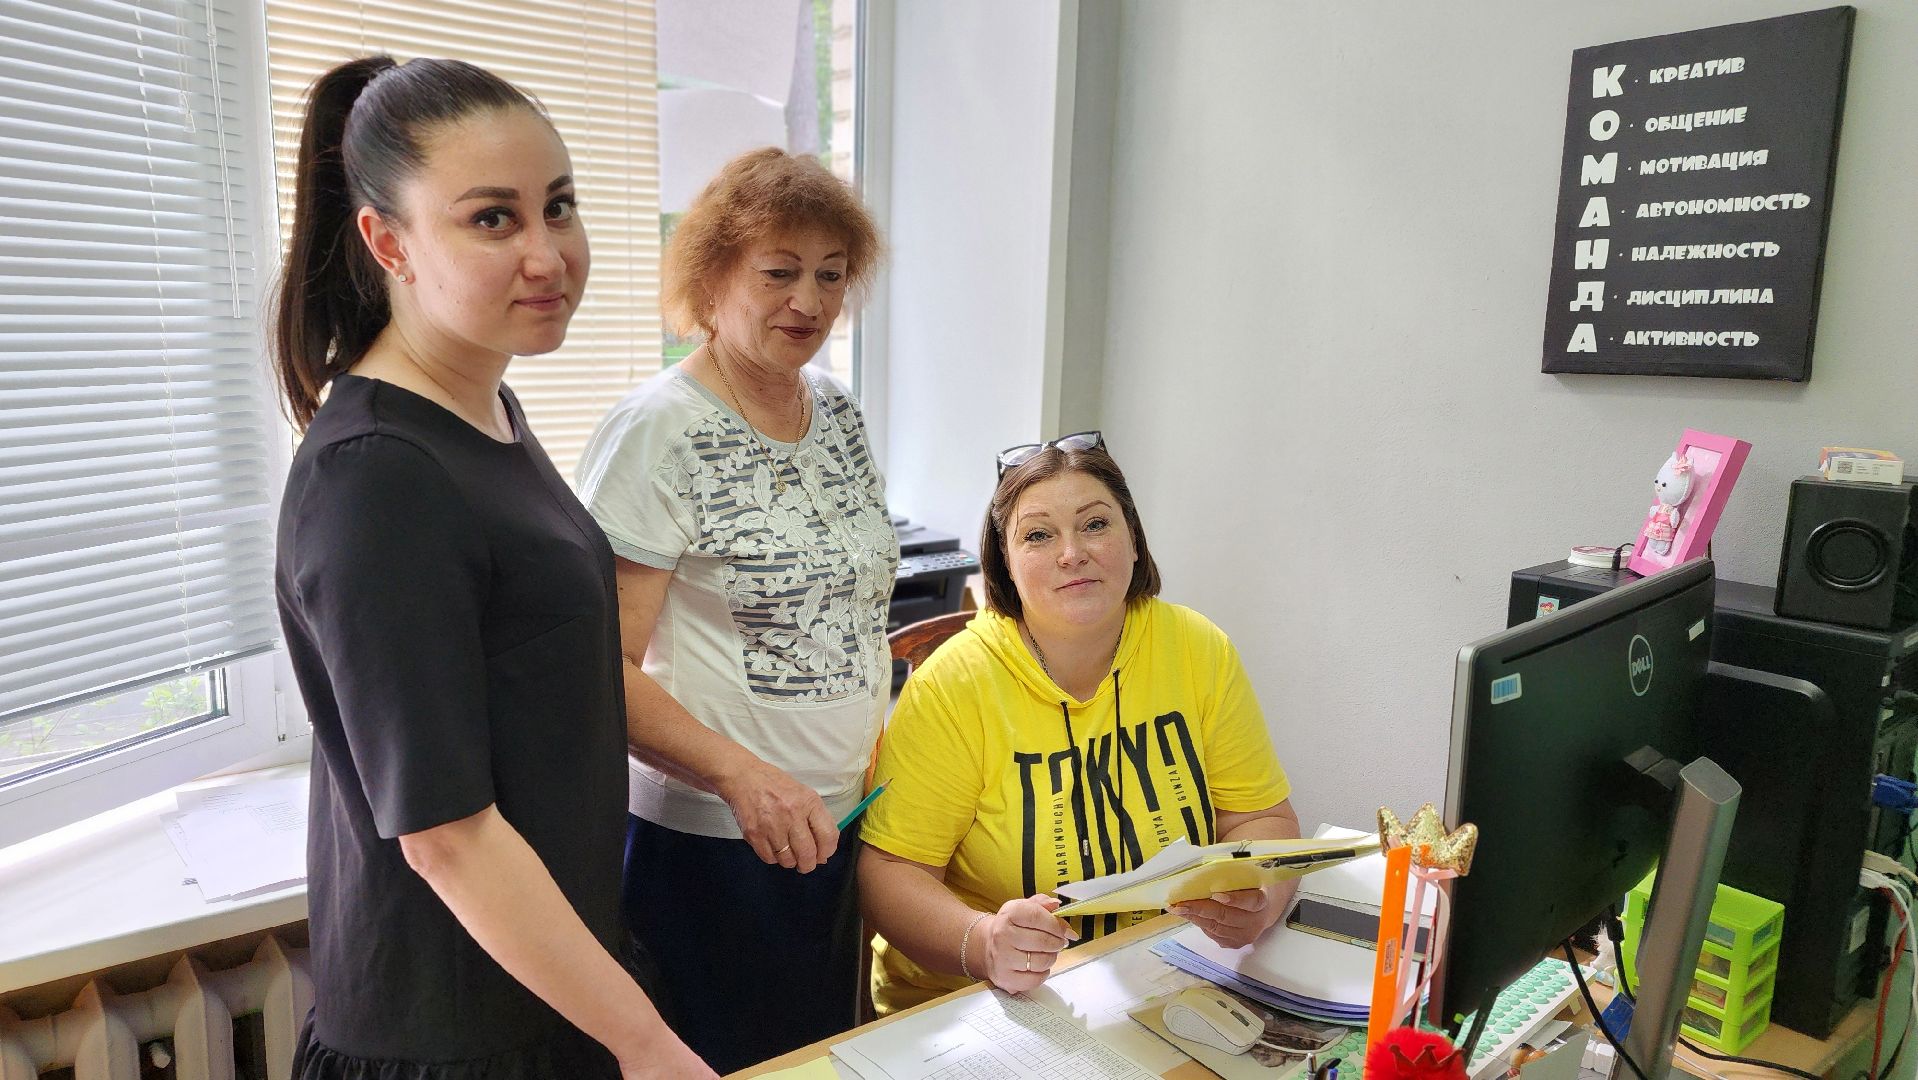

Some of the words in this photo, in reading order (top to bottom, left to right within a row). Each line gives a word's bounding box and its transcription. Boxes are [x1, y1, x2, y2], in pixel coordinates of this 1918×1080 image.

[1649, 56, 1746, 85] КРЕАТИВ
[1644, 106, 1748, 133] ОБЩЕНИЕ
[1639, 149, 1770, 176] МОТИВАЦИЯ
[1635, 192, 1811, 219] АВТОНОМНОСТЬ
[1631, 241, 1781, 262] НАДЕЖНОСТЬ
[1622, 330, 1760, 347] АКТИВНОСТЬ
[1631, 655, 1651, 677] DELL
[1168, 769, 1186, 802] GINZA
[1014, 711, 1217, 938] TOKYO
[1053, 797, 1069, 876] MARUNOUCHI
